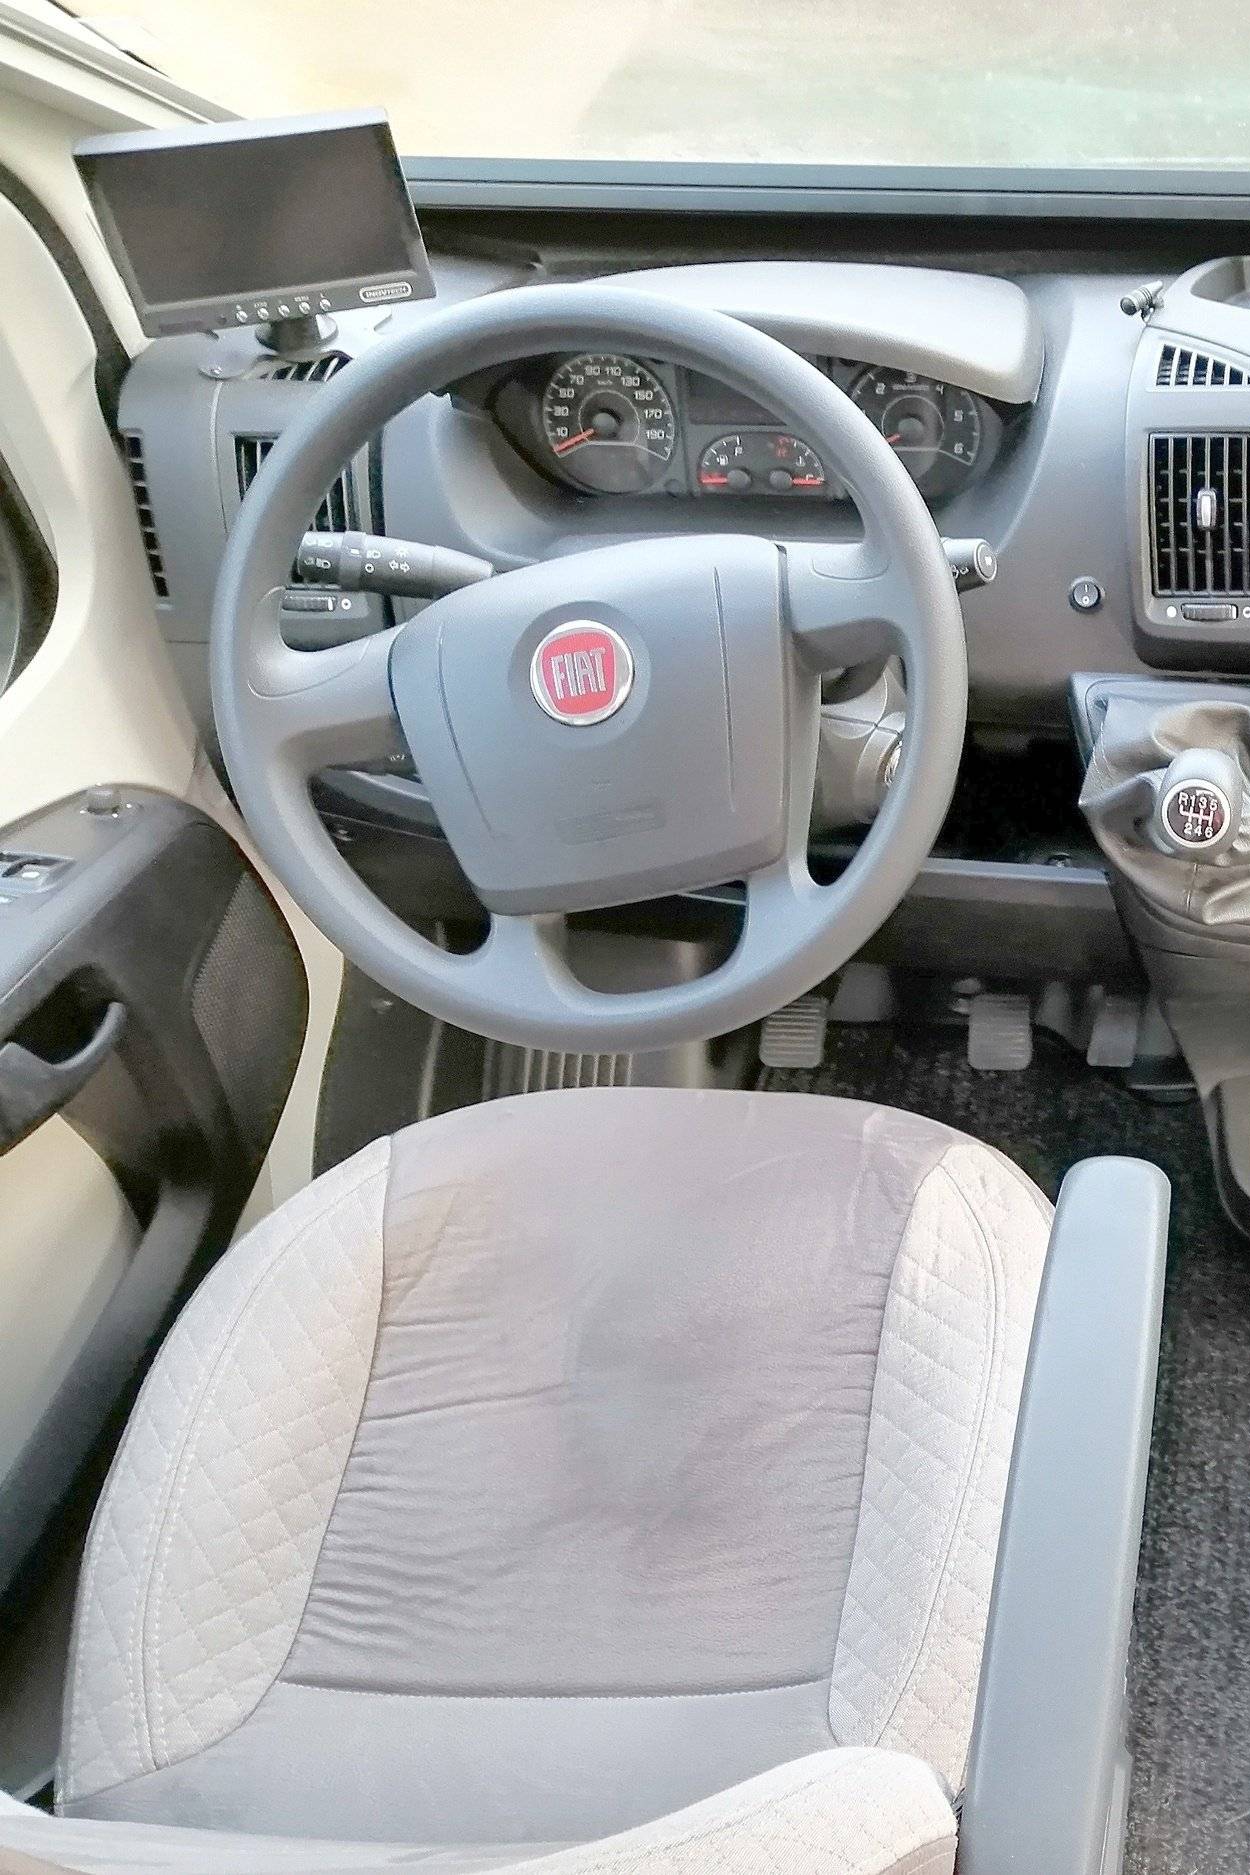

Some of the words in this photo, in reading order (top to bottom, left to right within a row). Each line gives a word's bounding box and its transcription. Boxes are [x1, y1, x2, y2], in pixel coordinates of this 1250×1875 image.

[570, 374, 585, 386] 70
[644, 408, 663, 420] 170
[556, 426, 569, 438] 10
[646, 429, 665, 440] 190
[550, 647, 607, 701] FIAT
[1179, 791, 1189, 806] R
[1190, 794, 1196, 807] 1
[1199, 796, 1208, 810] 3
[1209, 798, 1218, 811] 5
[1183, 822, 1193, 836] 2
[1194, 824, 1203, 837] 4
[1204, 826, 1214, 839] 6
